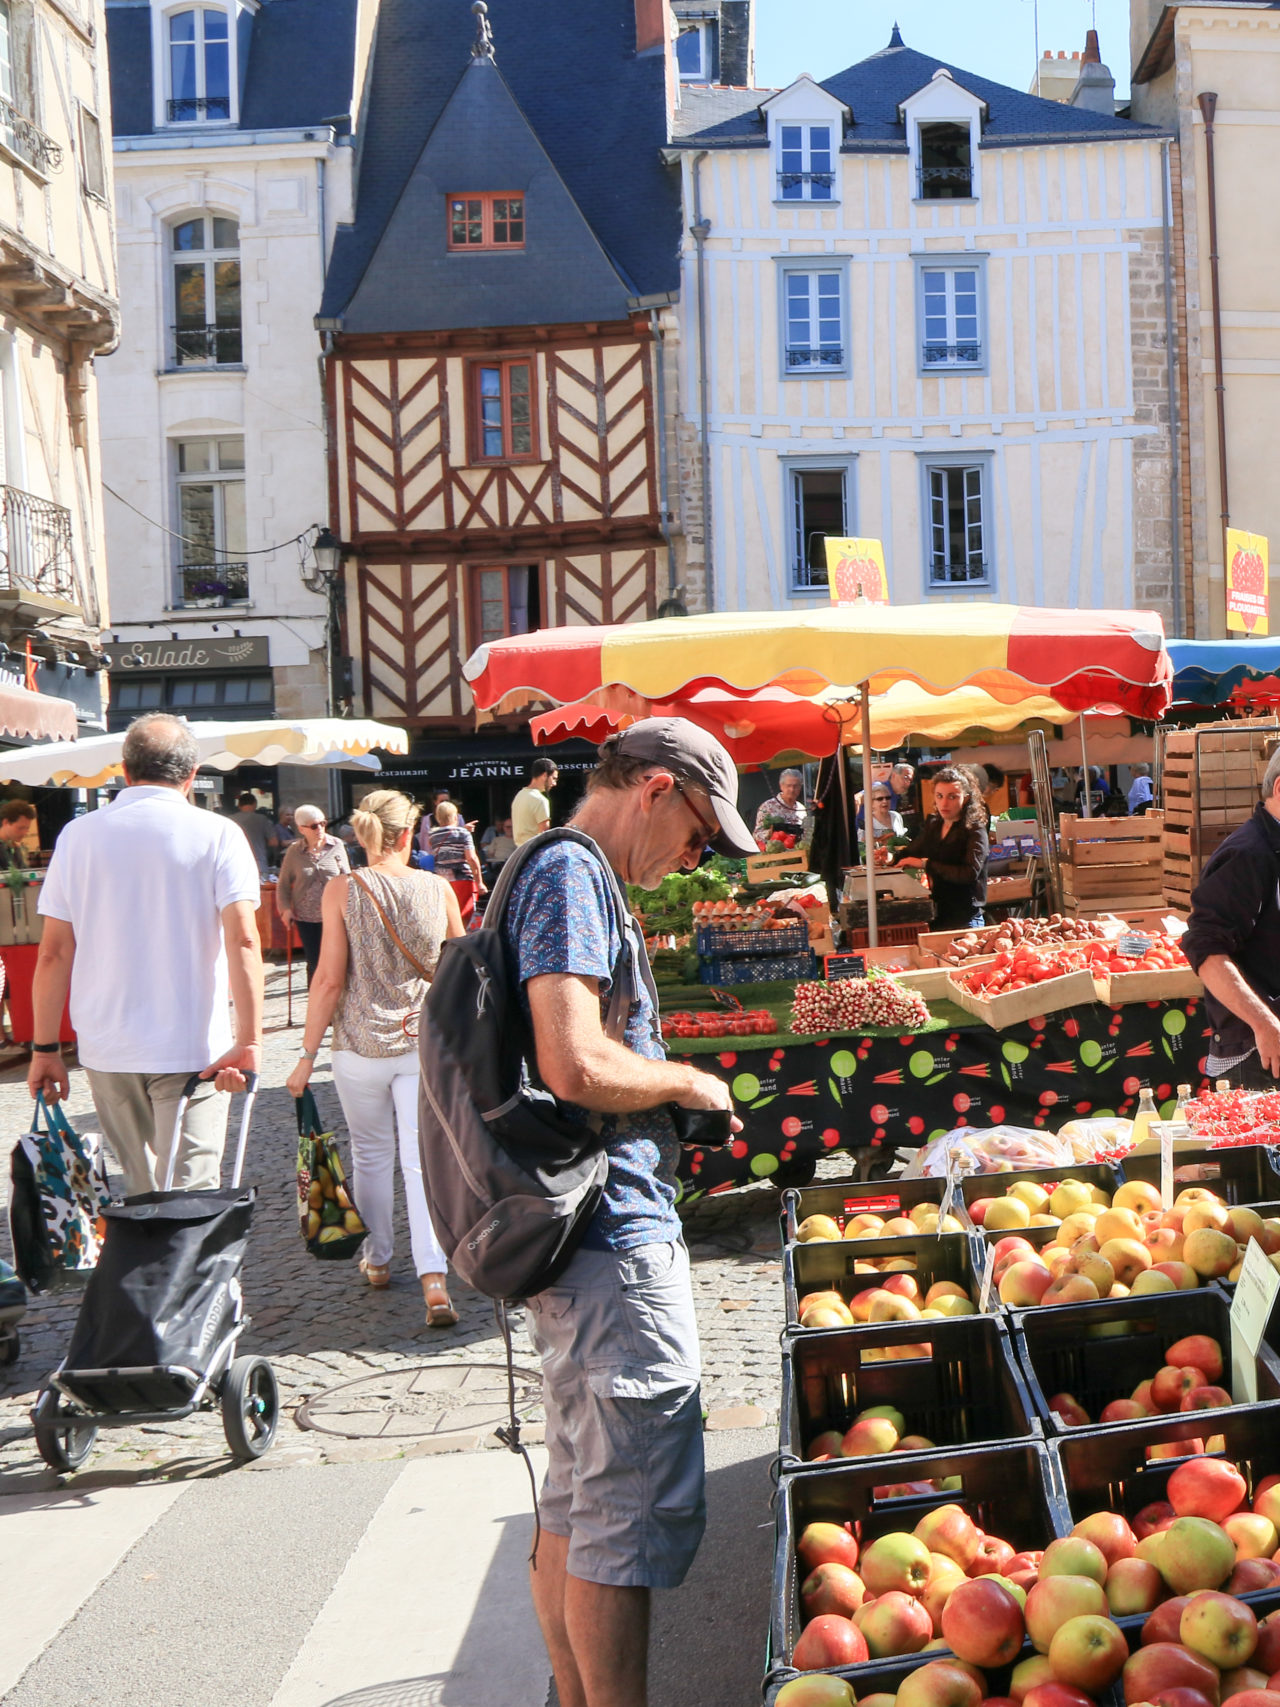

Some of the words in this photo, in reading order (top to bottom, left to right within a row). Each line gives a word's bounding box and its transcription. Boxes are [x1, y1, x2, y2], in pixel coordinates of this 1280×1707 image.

[1231, 590, 1257, 604] FRAISES
[1257, 595, 1265, 606] DE
[1229, 601, 1267, 616] PLOUGASTEL
[121, 642, 210, 669] Salade
[448, 765, 525, 779] JEANNE
[466, 1219, 500, 1251] Quechua
